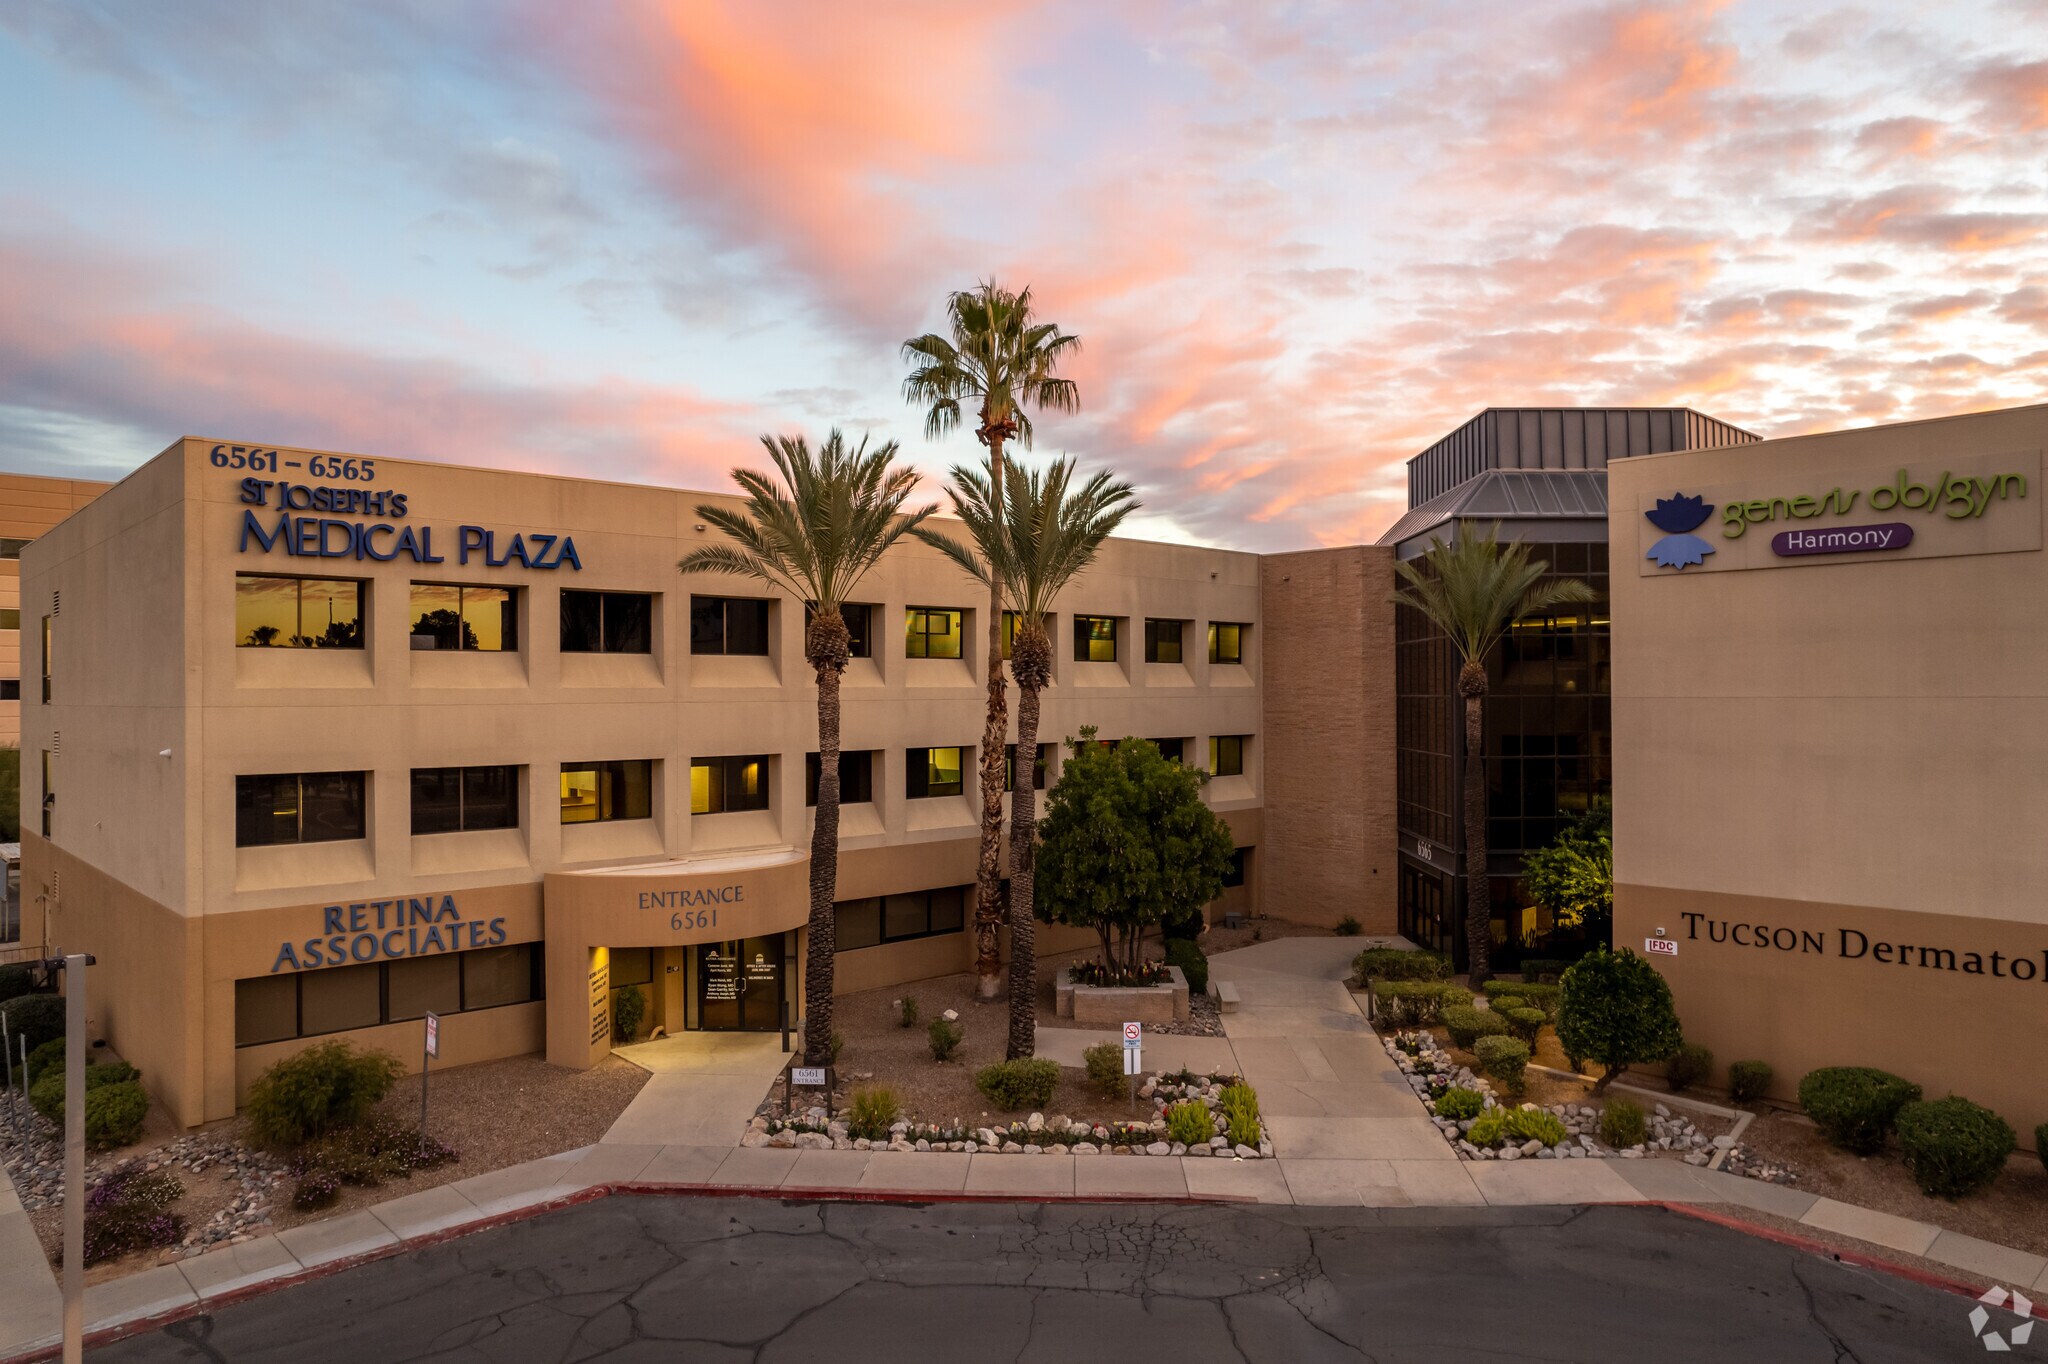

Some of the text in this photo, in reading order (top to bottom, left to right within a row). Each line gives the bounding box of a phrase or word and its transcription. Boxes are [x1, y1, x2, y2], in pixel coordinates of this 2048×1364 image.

[210, 445, 278, 473] 6561
[309, 455, 375, 482] 6565
[240, 477, 408, 518] ST JOSEPH'S
[1722, 469, 2026, 539] genesis ob/gyn
[240, 509, 582, 571] MEDICAL PLAZA
[1788, 529, 1893, 549] Harmony
[1417, 840, 1432, 860] 6565
[324, 895, 460, 935] RETINA
[638, 886, 744, 910] ENTRANCE
[671, 910, 717, 930] 6561
[1681, 912, 1825, 954] TUCSON
[271, 917, 506, 972] ASSOCIATES
[798, 1069, 818, 1078] 6561
